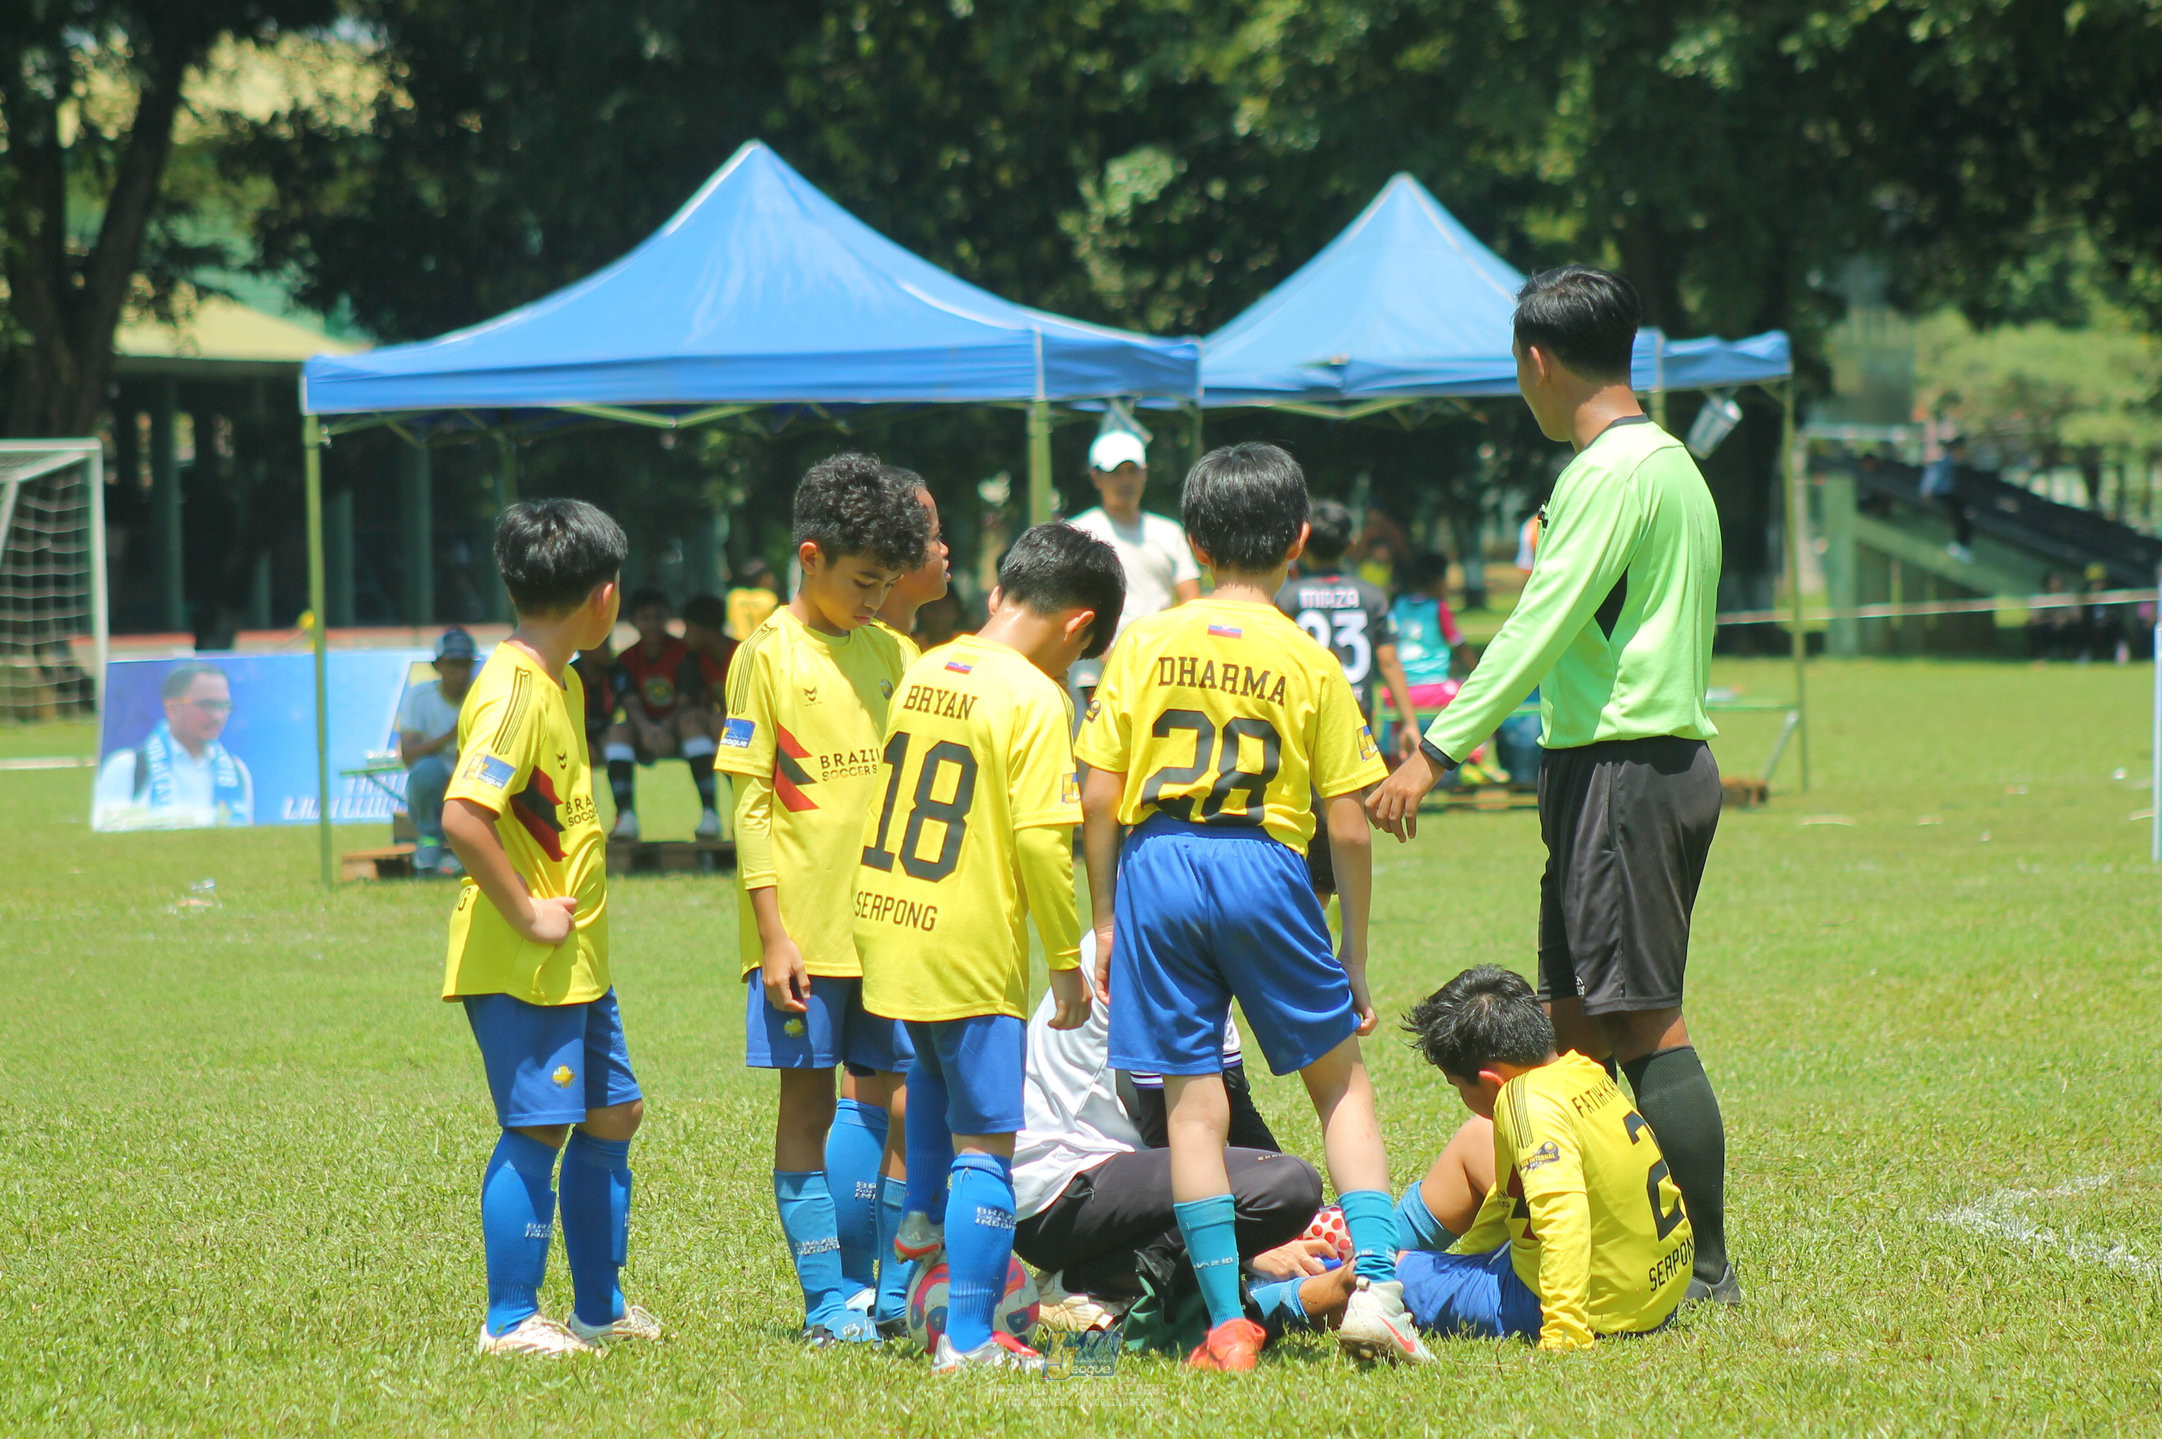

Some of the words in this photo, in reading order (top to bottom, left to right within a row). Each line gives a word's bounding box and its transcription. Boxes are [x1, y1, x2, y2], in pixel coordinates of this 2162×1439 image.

[903, 685, 978, 720] BRYAN
[1158, 656, 1287, 707] DHARMA
[1141, 709, 1282, 827] 28
[566, 794, 596, 815] BRA
[860, 731, 978, 883] 18
[854, 891, 938, 931] SERPONG
[1649, 1234, 1694, 1292] SERPON
